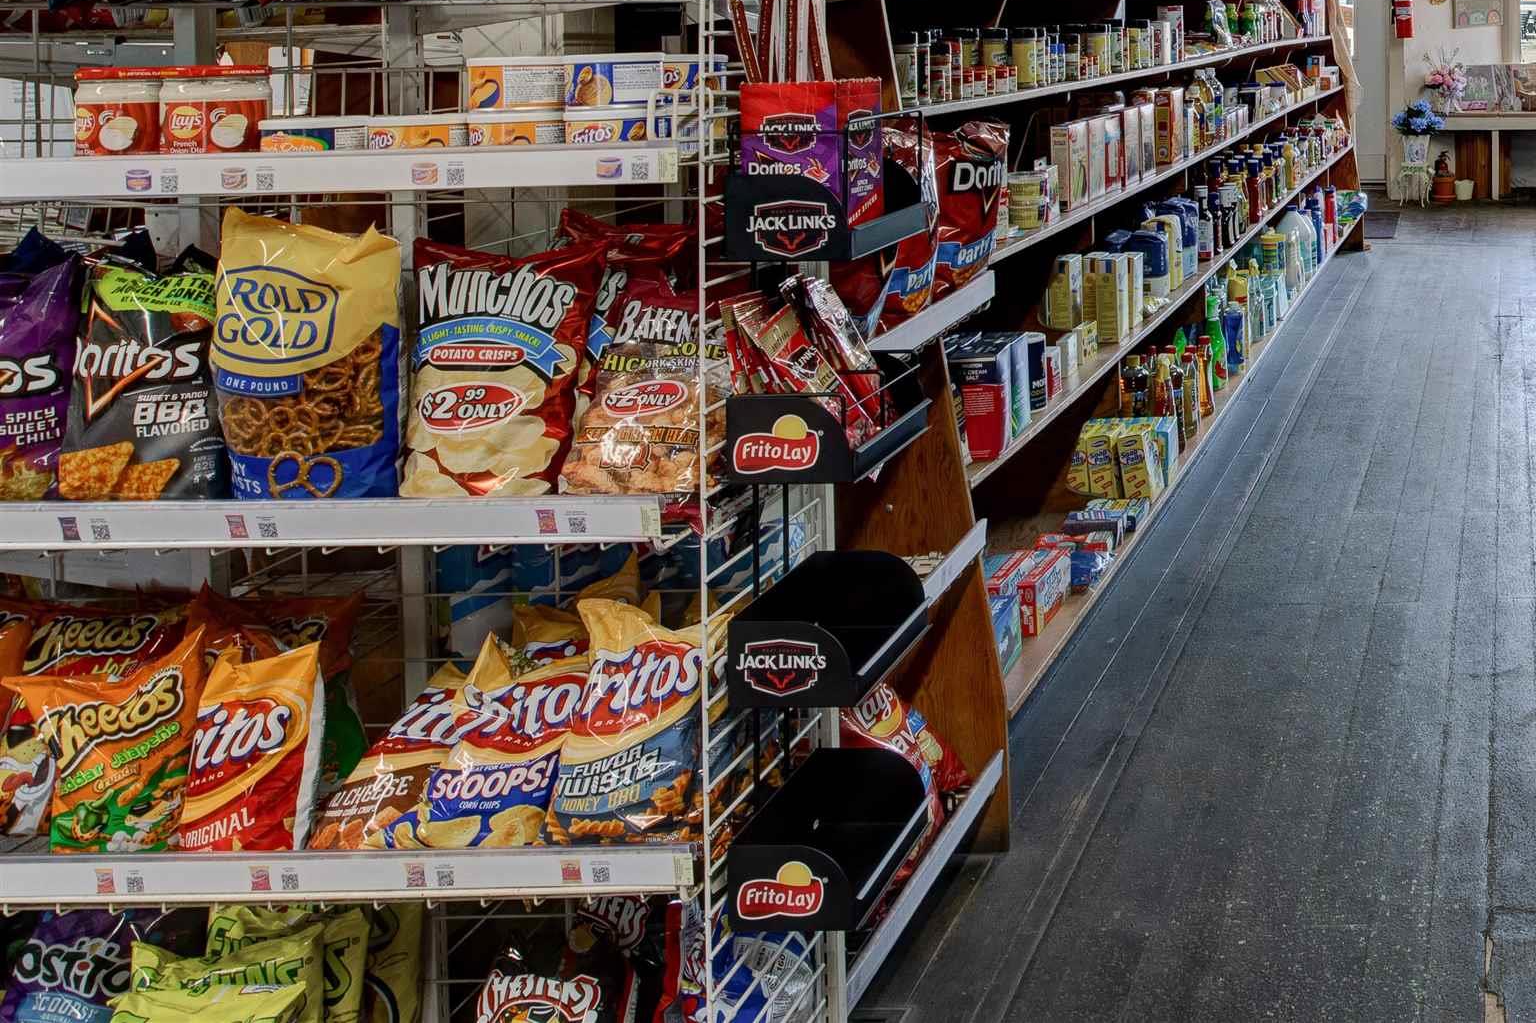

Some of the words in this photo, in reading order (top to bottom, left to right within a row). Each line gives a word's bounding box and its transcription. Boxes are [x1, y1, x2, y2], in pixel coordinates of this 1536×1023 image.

[370, 134, 394, 150] itos
[748, 162, 801, 176] Doritos
[746, 215, 788, 233] JACK
[788, 214, 836, 230] LINK'S
[166, 288, 215, 305] CONFE
[226, 276, 328, 316] ROLD
[217, 313, 321, 352] GOLD
[616, 301, 699, 347] BAKEN
[432, 348, 476, 361] POTATO
[478, 348, 519, 361] CRISPS
[225, 377, 246, 390] ONE
[249, 380, 289, 392] POUND
[137, 392, 166, 402] SWEET
[178, 389, 209, 400] TANGY
[638, 394, 676, 407] ONLY
[5, 406, 56, 424] SPICY
[134, 399, 207, 426] BBQ
[457, 401, 513, 419] ONLY
[0, 418, 60, 436] SWEET
[135, 419, 209, 438] FLAVORED
[16, 429, 61, 446] CHILI
[736, 653, 776, 670] JACK
[778, 651, 826, 669] LINK'S
[581, 648, 703, 716] Fritos
[459, 680, 584, 741] Frito
[39, 676, 178, 770] Cheetos
[189, 702, 292, 771] itos
[573, 745, 644, 778] FLAVOR
[432, 753, 558, 800] SCOOPS!
[559, 749, 661, 797] TWISTS
[459, 800, 478, 809] CORN
[479, 800, 501, 810] CHIPS
[562, 797, 600, 812] HONEY
[607, 785, 641, 807] BBQ
[186, 808, 256, 849] ORIGINAL
